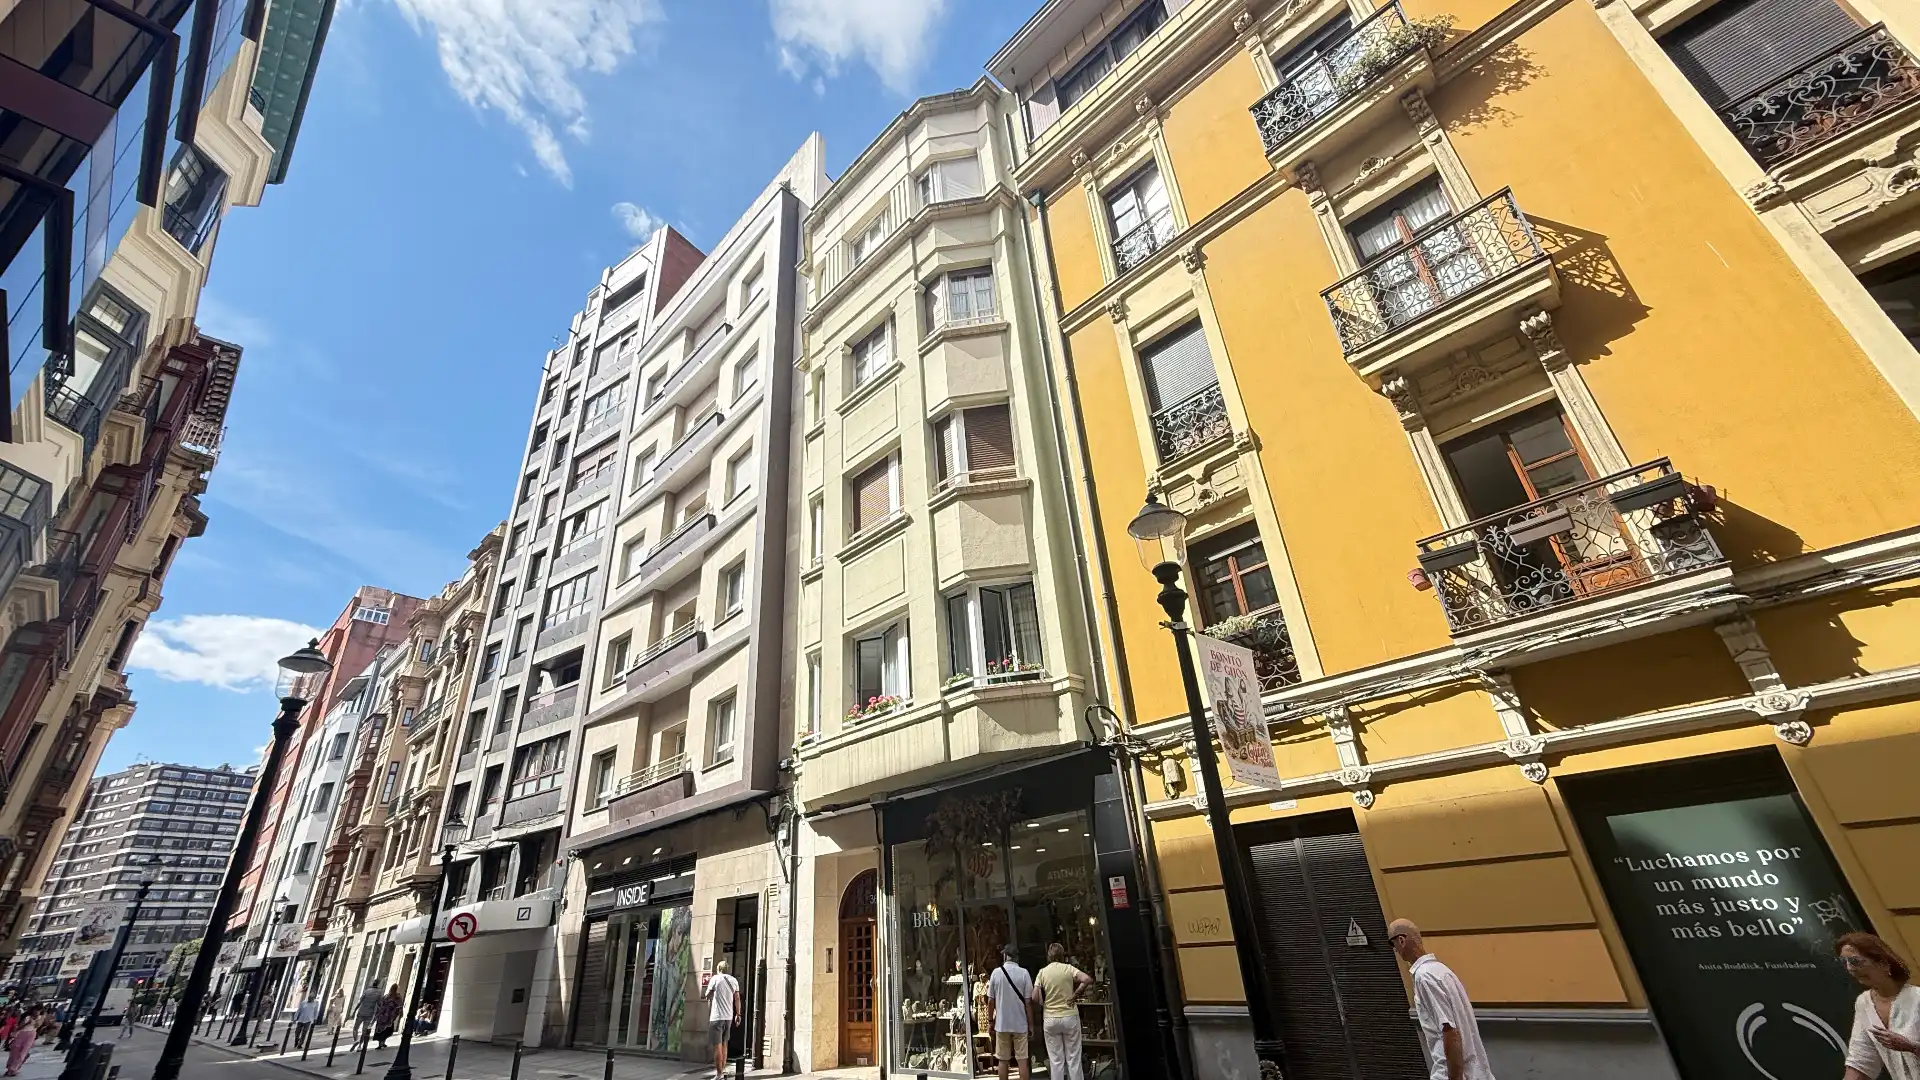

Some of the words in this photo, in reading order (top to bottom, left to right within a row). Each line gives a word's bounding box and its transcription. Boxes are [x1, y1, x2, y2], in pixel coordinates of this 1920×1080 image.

[1210, 650, 1242, 667] BONITO
[1756, 846, 1801, 866] por
[1654, 879, 1684, 892] un
[1691, 869, 1779, 890] mundo
[616, 884, 648, 907] INSIDE
[1656, 899, 1705, 916] más
[1710, 897, 1778, 916] justo
[1784, 896, 1800, 914] y
[1671, 921, 1722, 939] más
[1699, 962, 1722, 970] Anita
[1764, 961, 1817, 970] Fundadora
